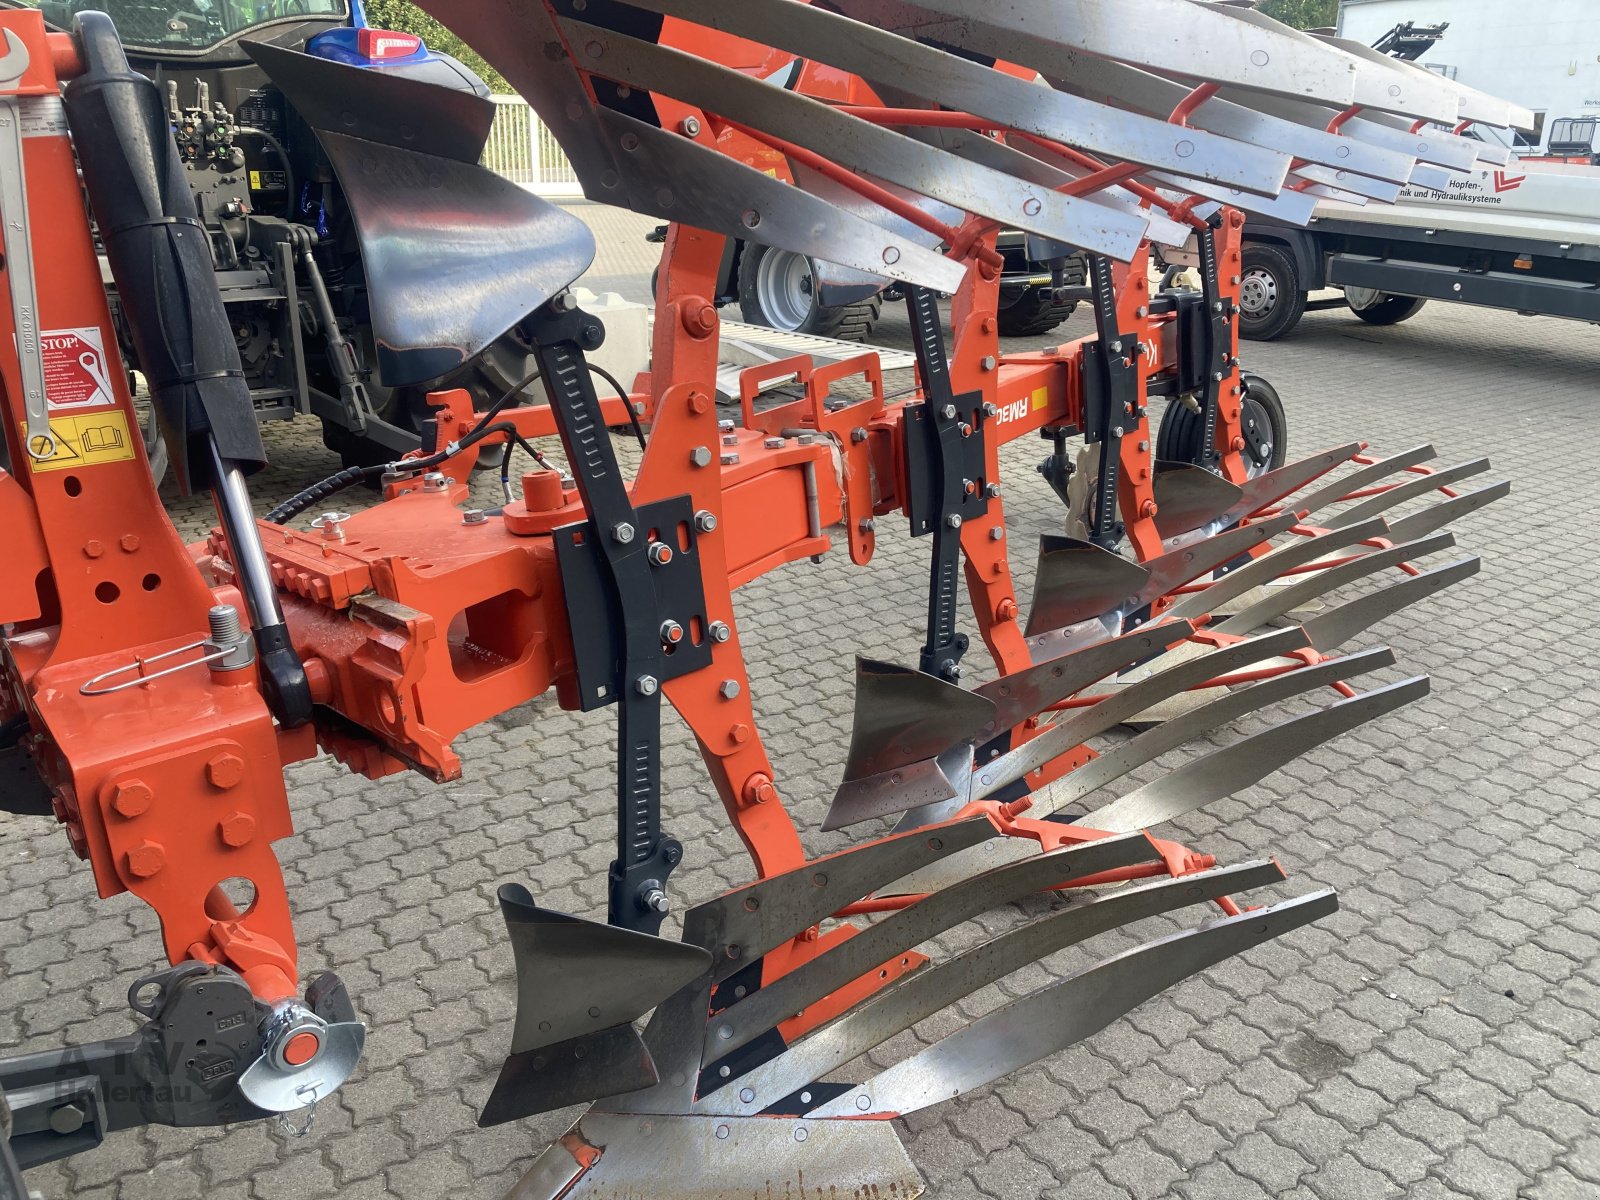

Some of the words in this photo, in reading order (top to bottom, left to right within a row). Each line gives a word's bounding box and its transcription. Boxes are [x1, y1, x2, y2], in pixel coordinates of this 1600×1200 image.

[1449, 179, 1483, 192] Hopfen-,
[1414, 190, 1428, 198] und
[1431, 191, 1501, 204] Hydrauliksysteme
[41, 337, 79, 350] STOP!
